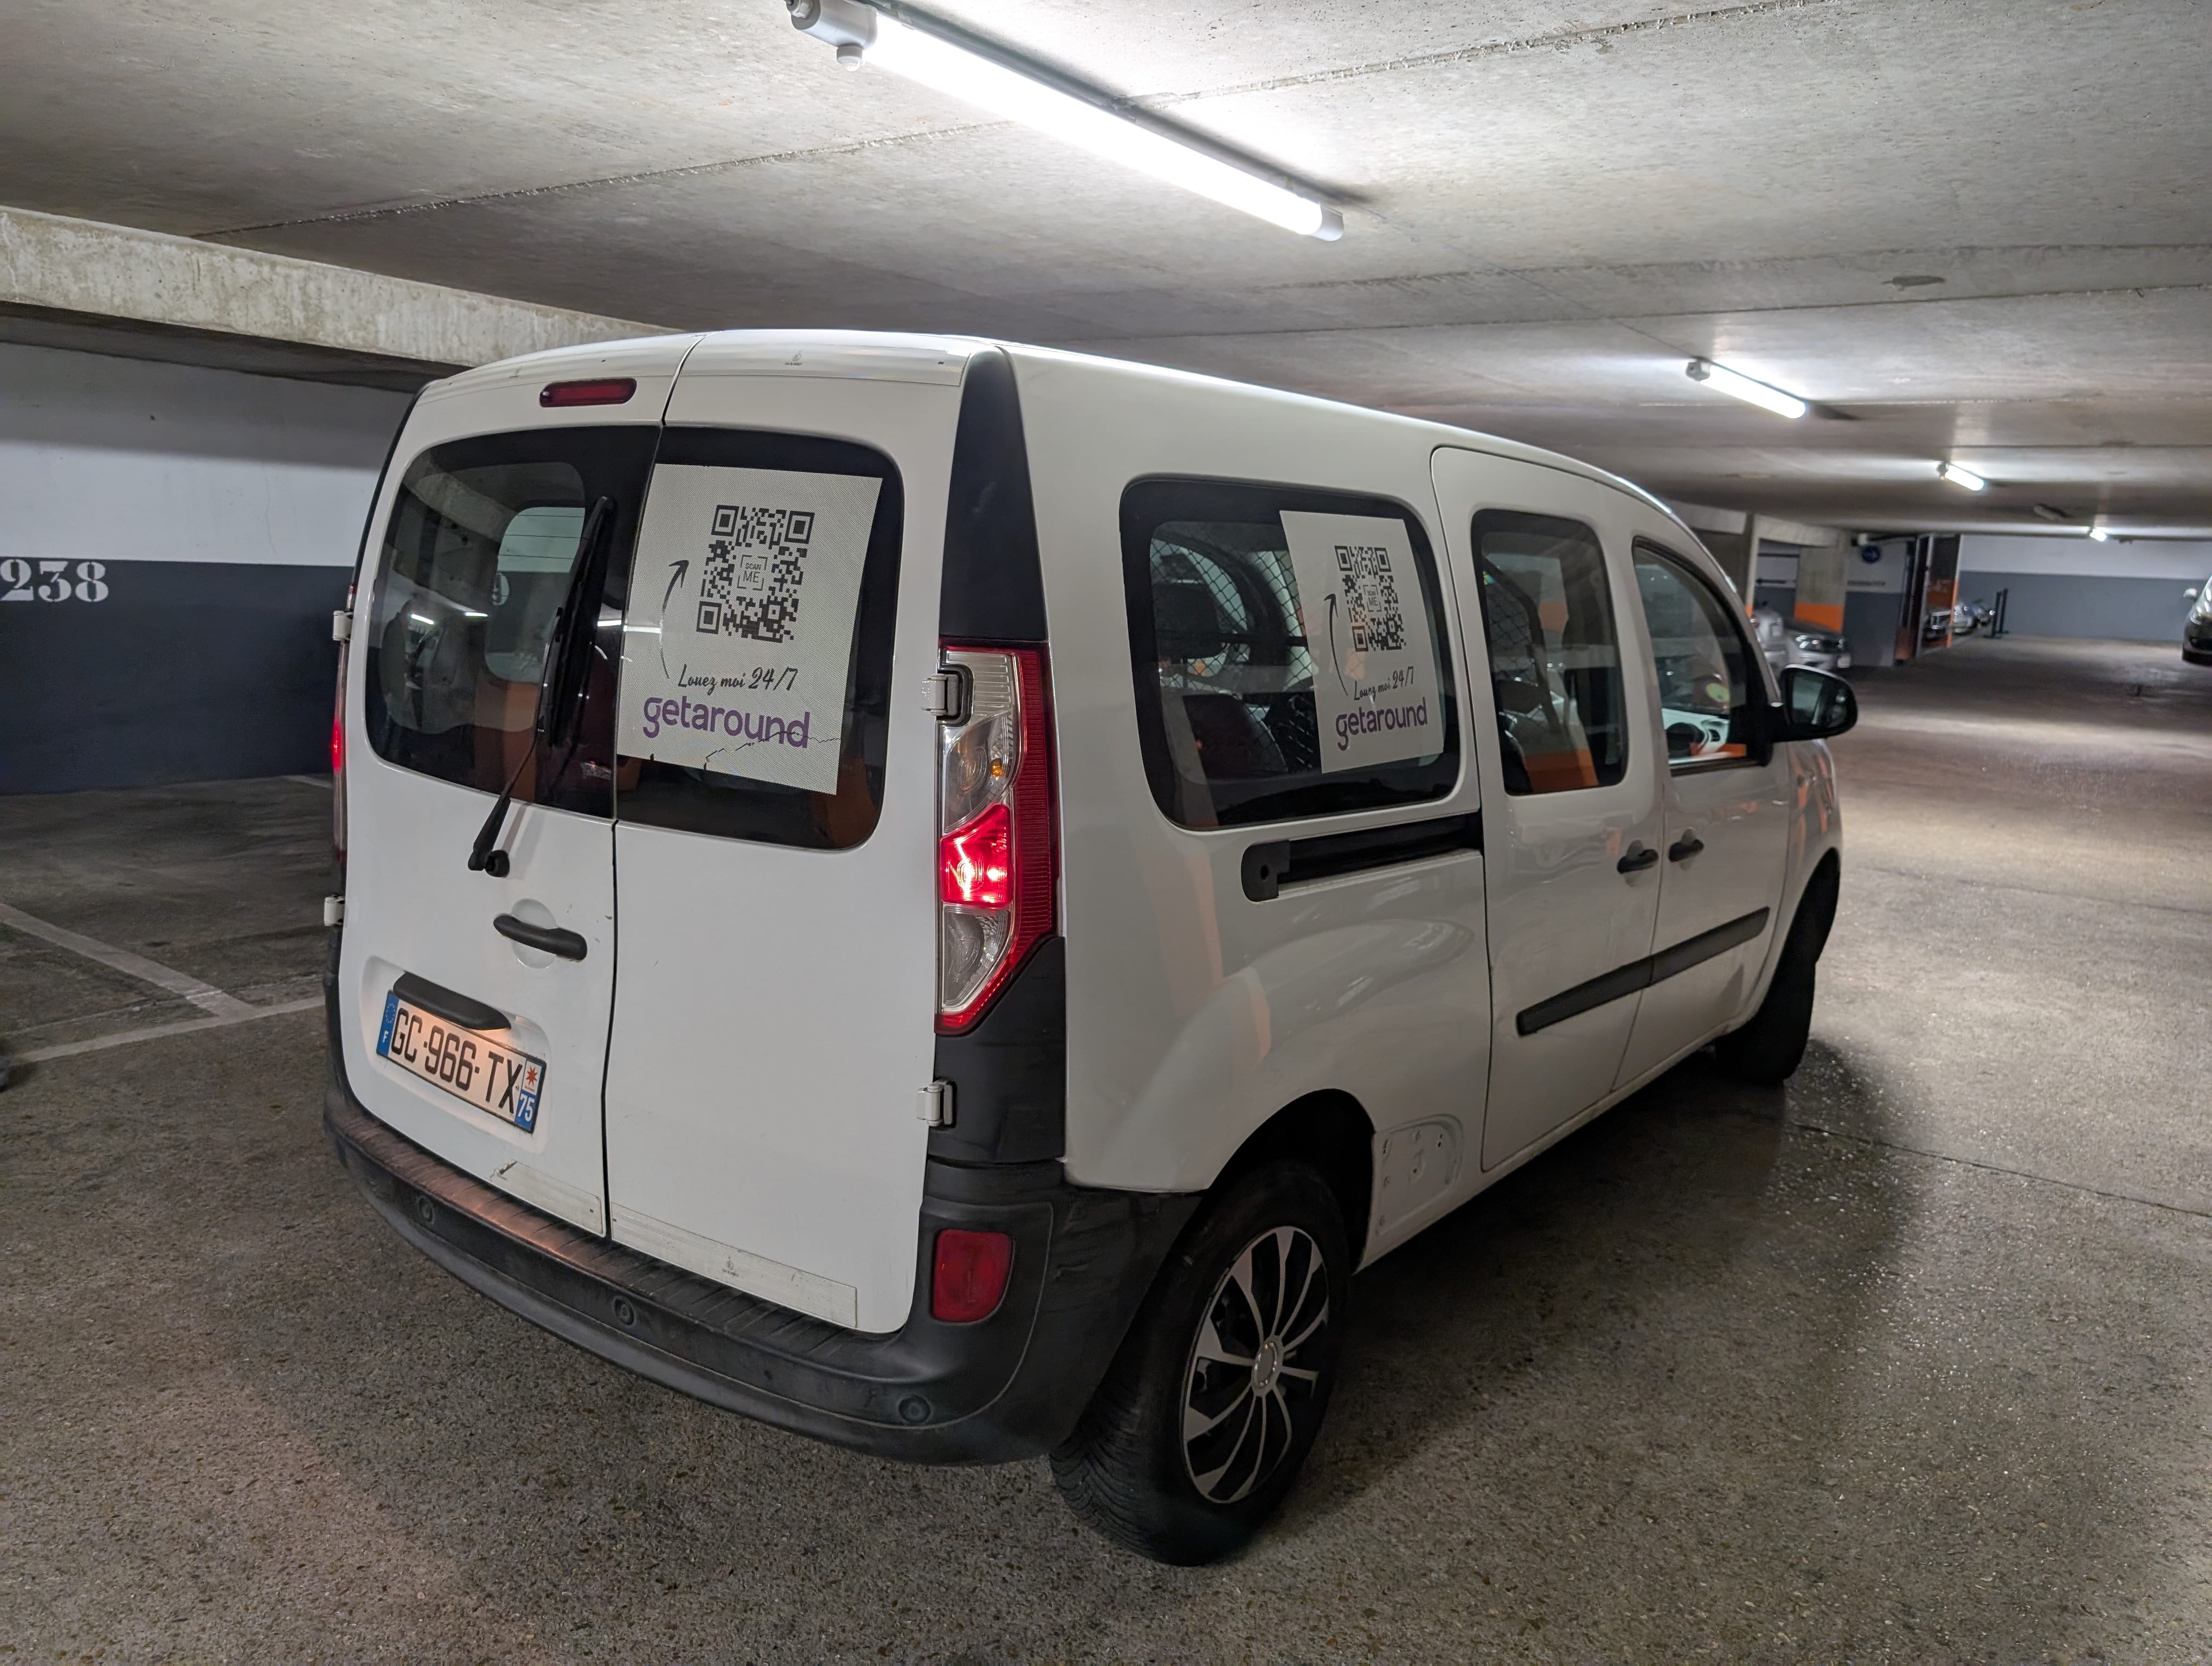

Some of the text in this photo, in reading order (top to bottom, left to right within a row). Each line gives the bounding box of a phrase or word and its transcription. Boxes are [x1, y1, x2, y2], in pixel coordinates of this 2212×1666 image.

[1, 559, 108, 602] 238
[743, 571, 760, 583] ME
[1368, 597, 1378, 606] ME
[678, 664, 798, 696] Louez moi 24/7
[1378, 678, 1391, 694] moi
[1392, 666, 1414, 689] 24/7
[642, 696, 810, 748] getaround
[1336, 697, 1427, 751] getaround
[382, 1030, 389, 1043] F
[519, 1093, 535, 1122] 75
